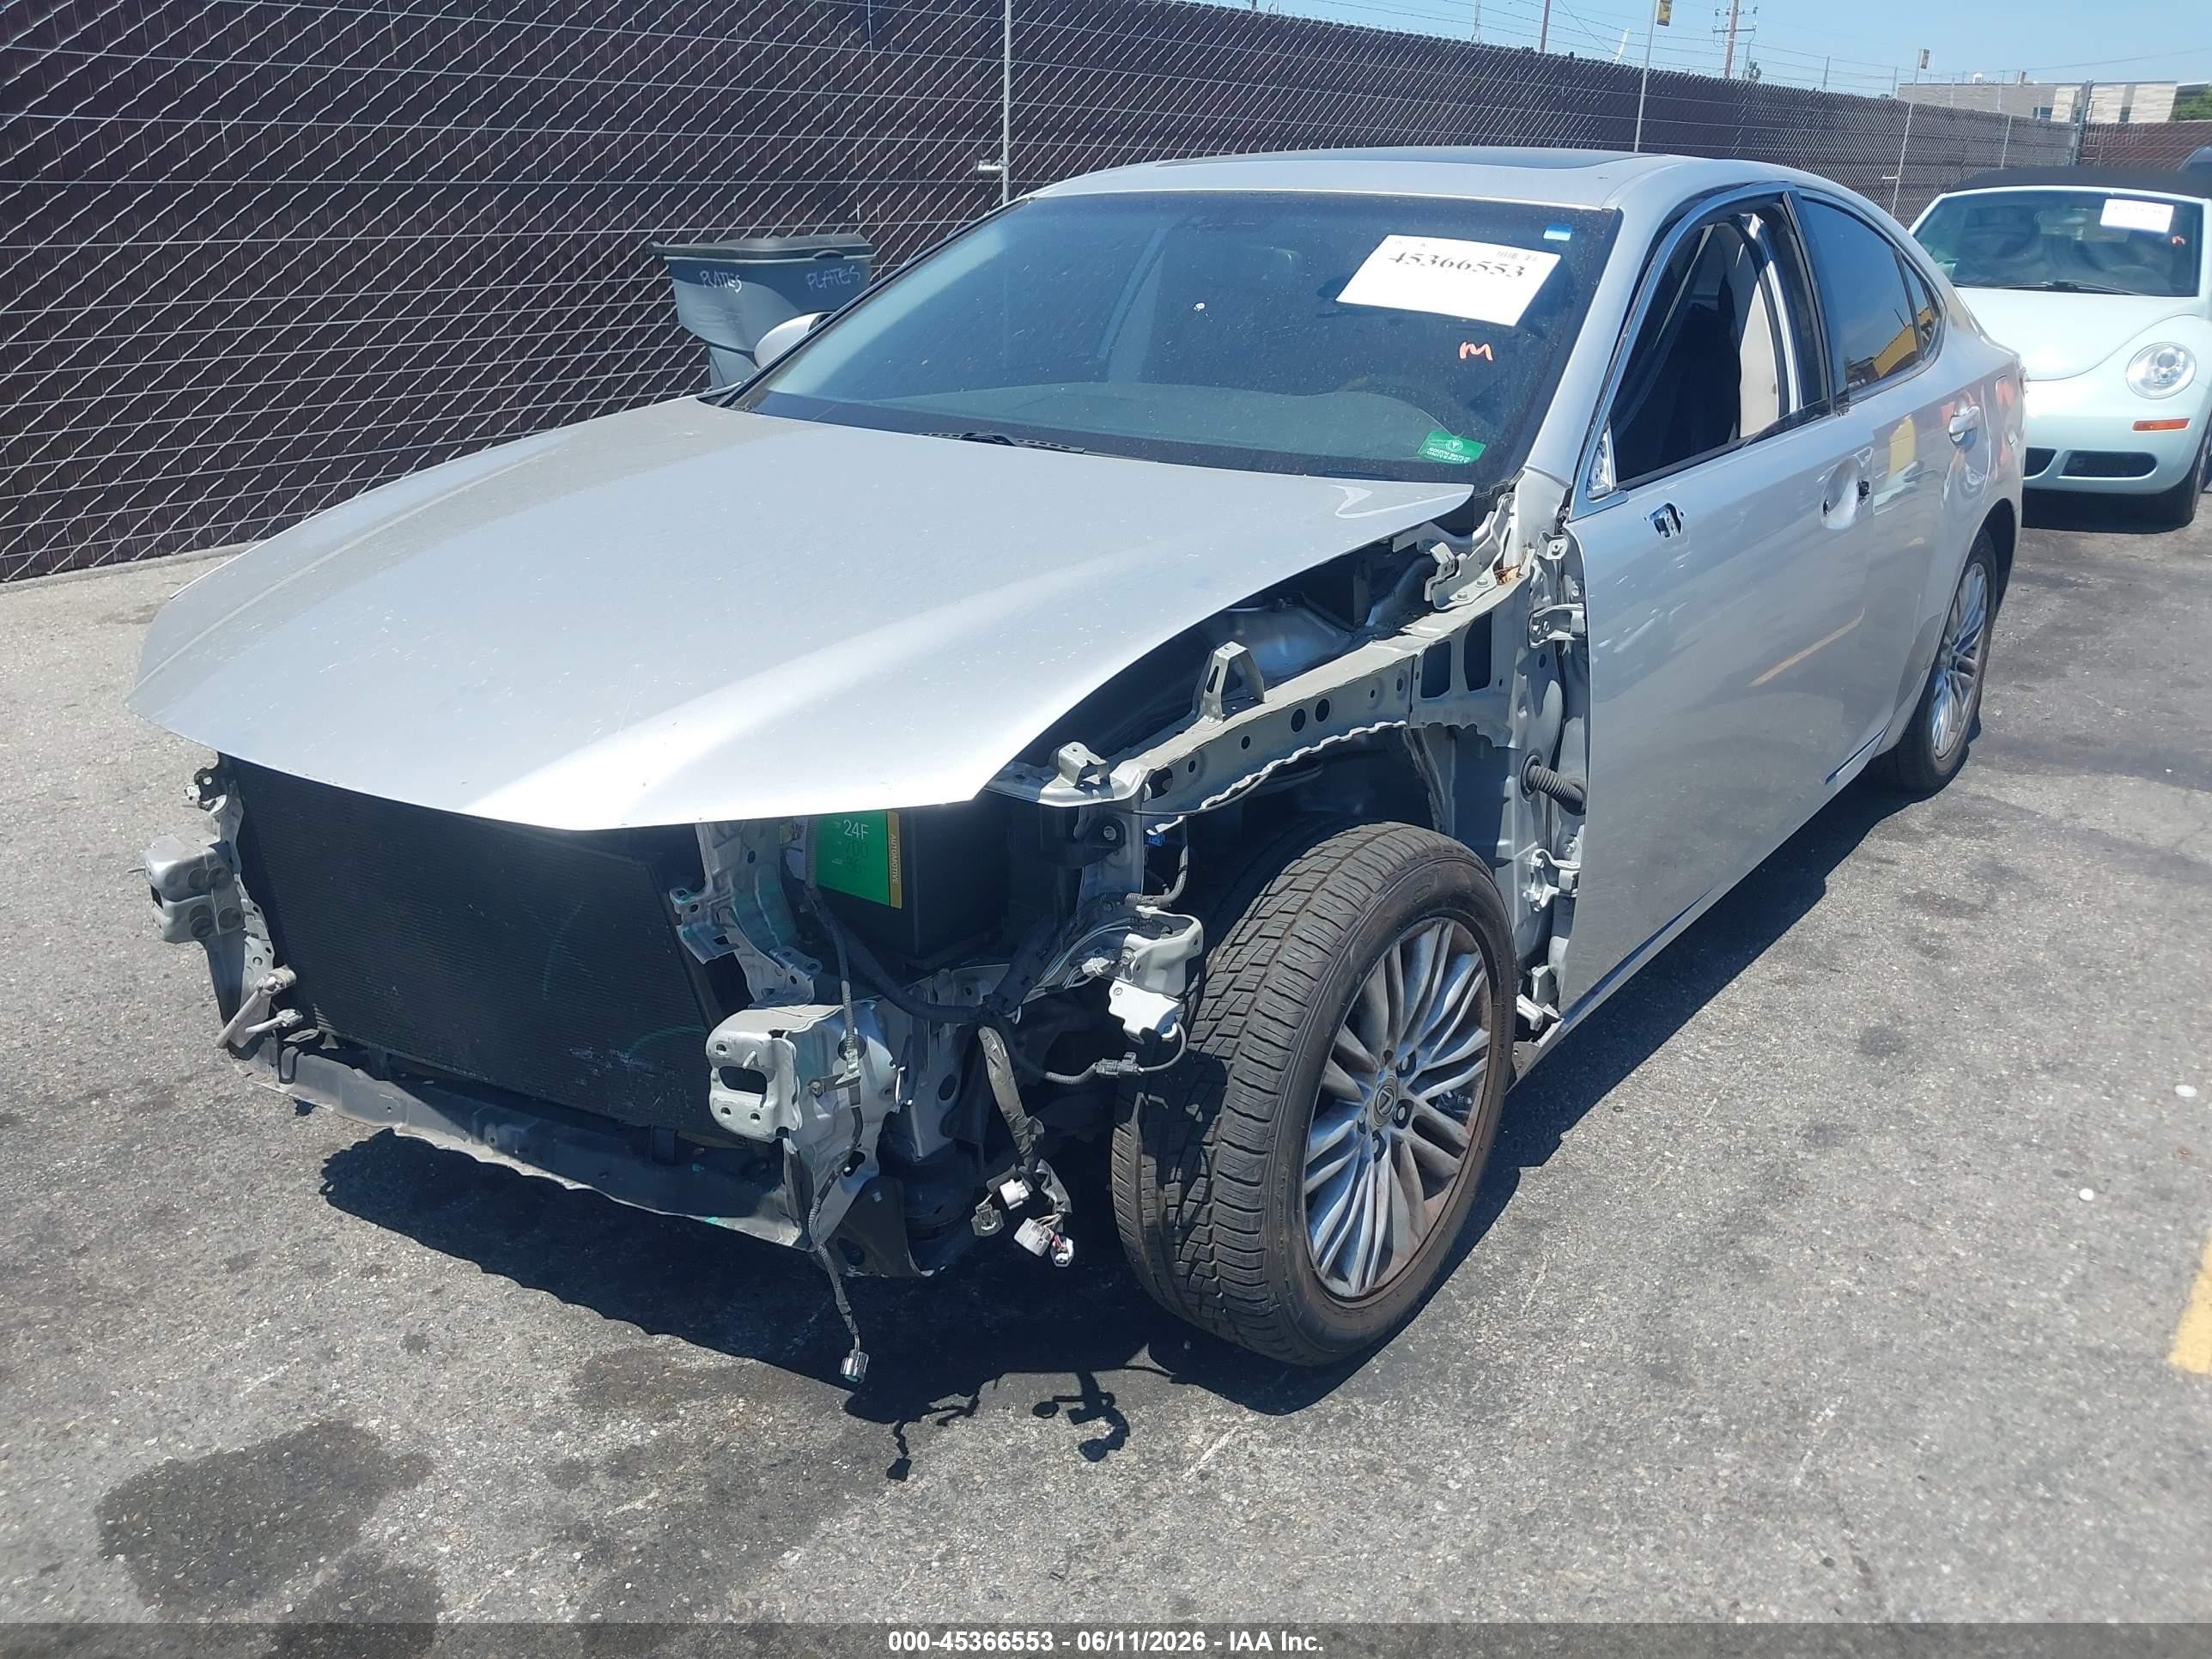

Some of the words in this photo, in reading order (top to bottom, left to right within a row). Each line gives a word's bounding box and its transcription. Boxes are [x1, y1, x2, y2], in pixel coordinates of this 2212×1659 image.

[805, 264, 860, 290] PLATES
[1388, 252, 1526, 277] 45366553
[843, 818, 870, 840] 24F
[890, 833, 899, 885] AUTOMOTIVE
